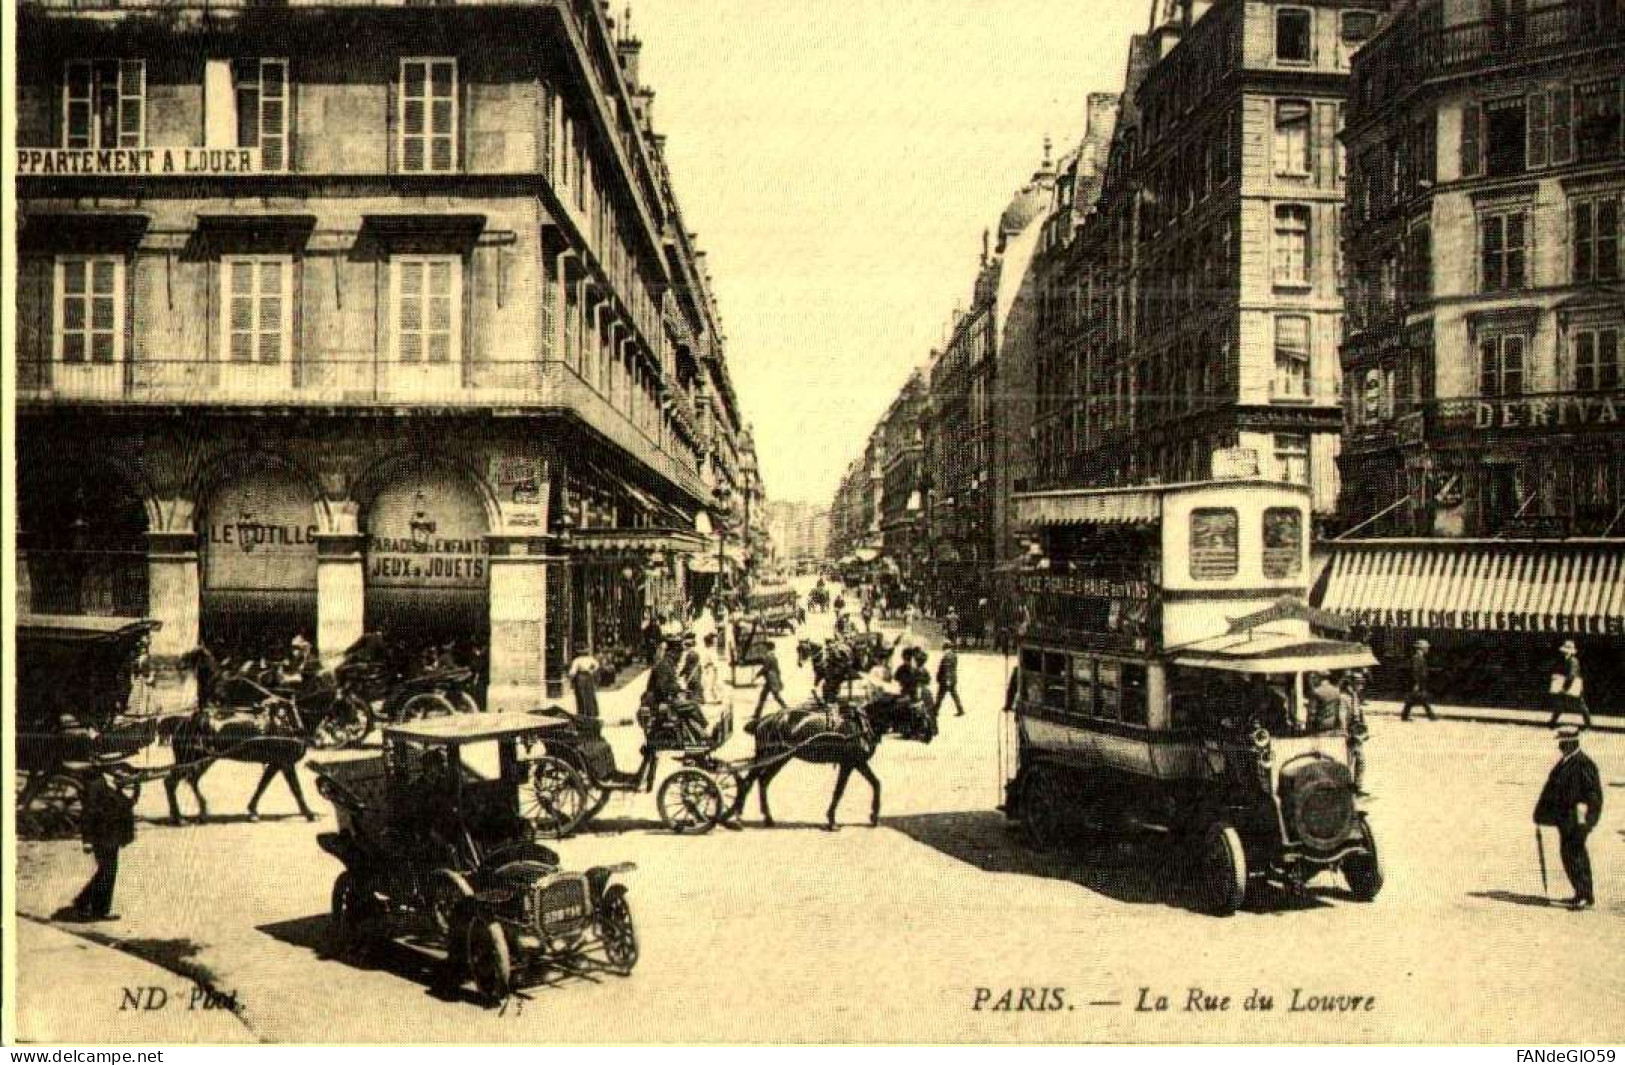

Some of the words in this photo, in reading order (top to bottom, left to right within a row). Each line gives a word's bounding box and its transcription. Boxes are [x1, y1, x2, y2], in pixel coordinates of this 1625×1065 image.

[162, 150, 176, 172] A
[184, 150, 252, 173] LOUER
[211, 524, 234, 544] LE
[373, 557, 411, 578] JEUX
[424, 557, 484, 578] JOUETS
